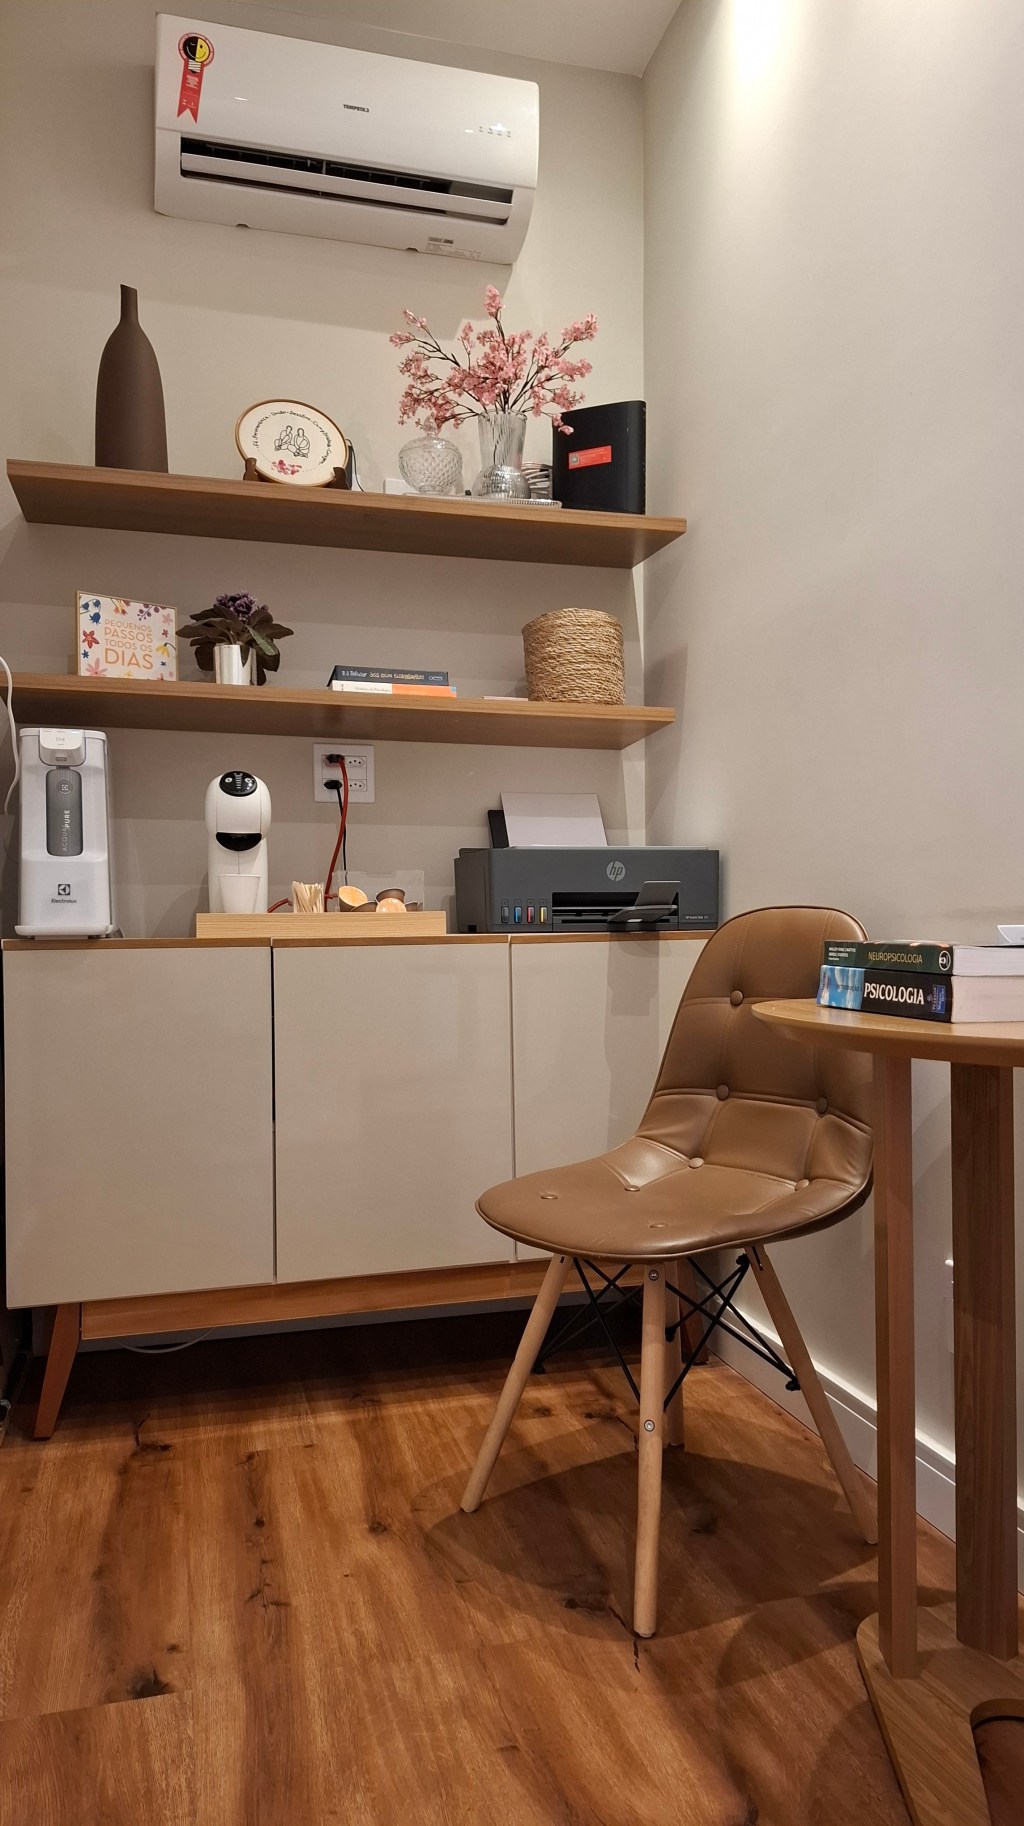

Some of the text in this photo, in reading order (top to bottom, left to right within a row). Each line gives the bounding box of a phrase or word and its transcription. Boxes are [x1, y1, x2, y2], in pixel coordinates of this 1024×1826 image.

[105, 619, 152, 632] PEQUENOS
[104, 627, 153, 643] PASSOS
[105, 639, 153, 653] TODOS OS
[105, 648, 154, 670] DIAS
[63, 809, 71, 828] PURE
[868, 951, 923, 964] NEUROPSICOLOGIA
[864, 982, 925, 1005] PSICOLOGIA
